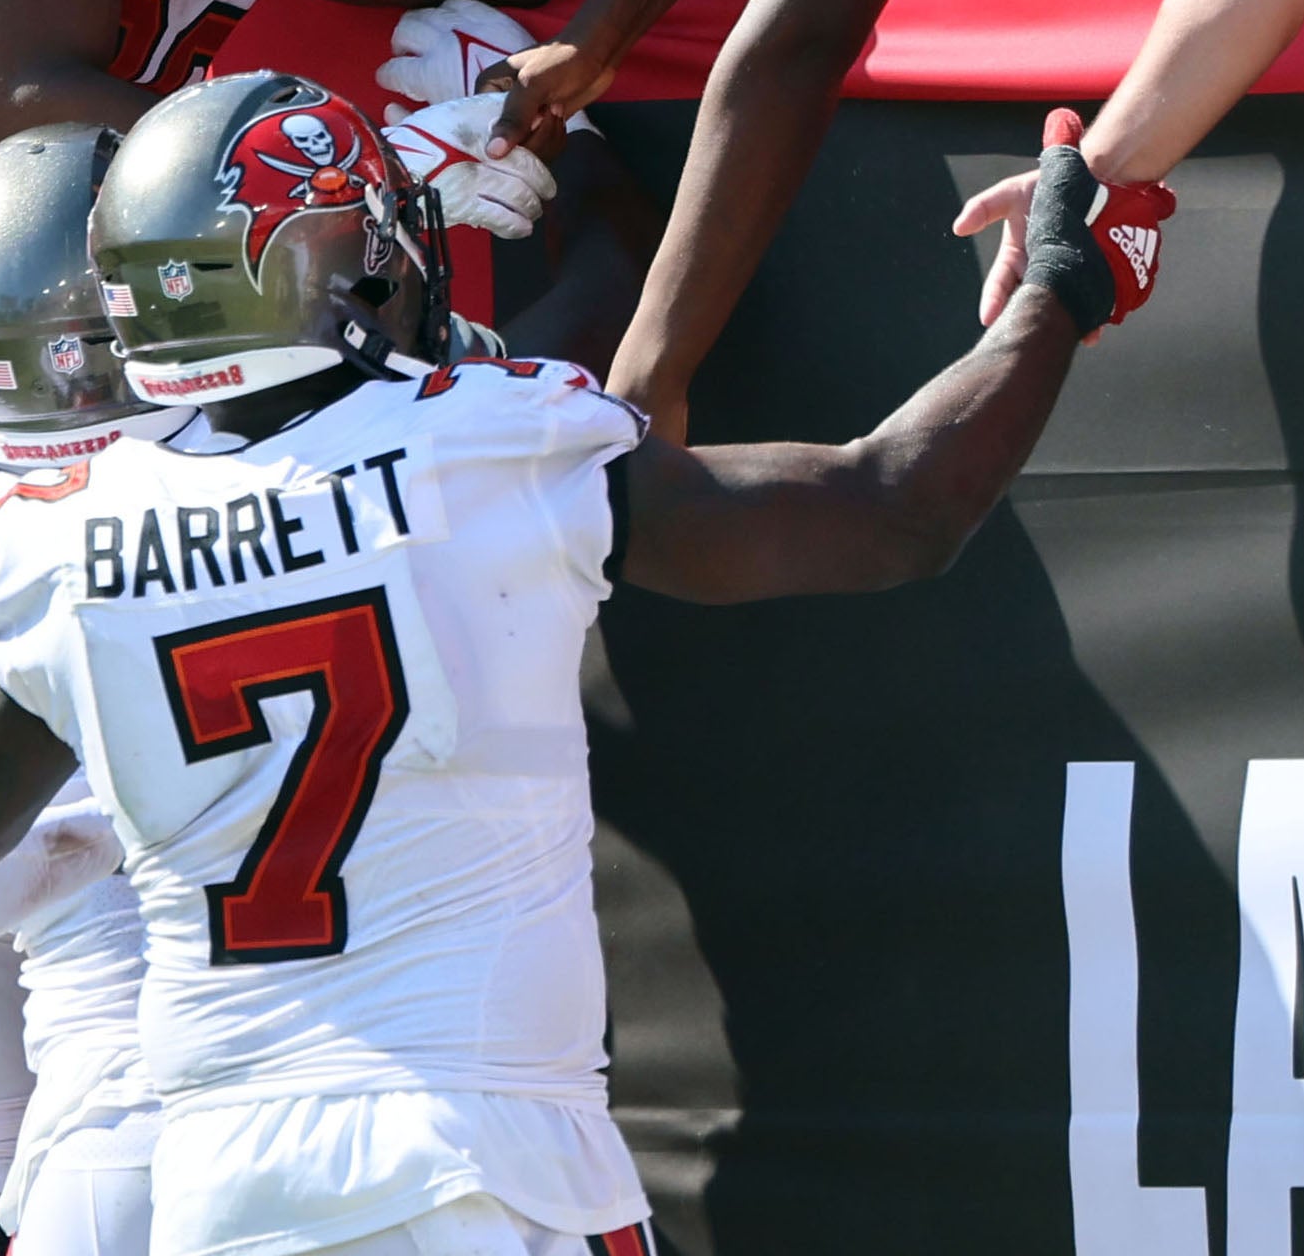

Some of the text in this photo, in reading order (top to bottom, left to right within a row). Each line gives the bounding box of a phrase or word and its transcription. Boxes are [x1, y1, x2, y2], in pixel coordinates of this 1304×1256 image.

[1108, 227, 1149, 290] adidas
[54, 353, 83, 369] NFL
[86, 447, 411, 599] BARRETT
[154, 585, 410, 965] 7
